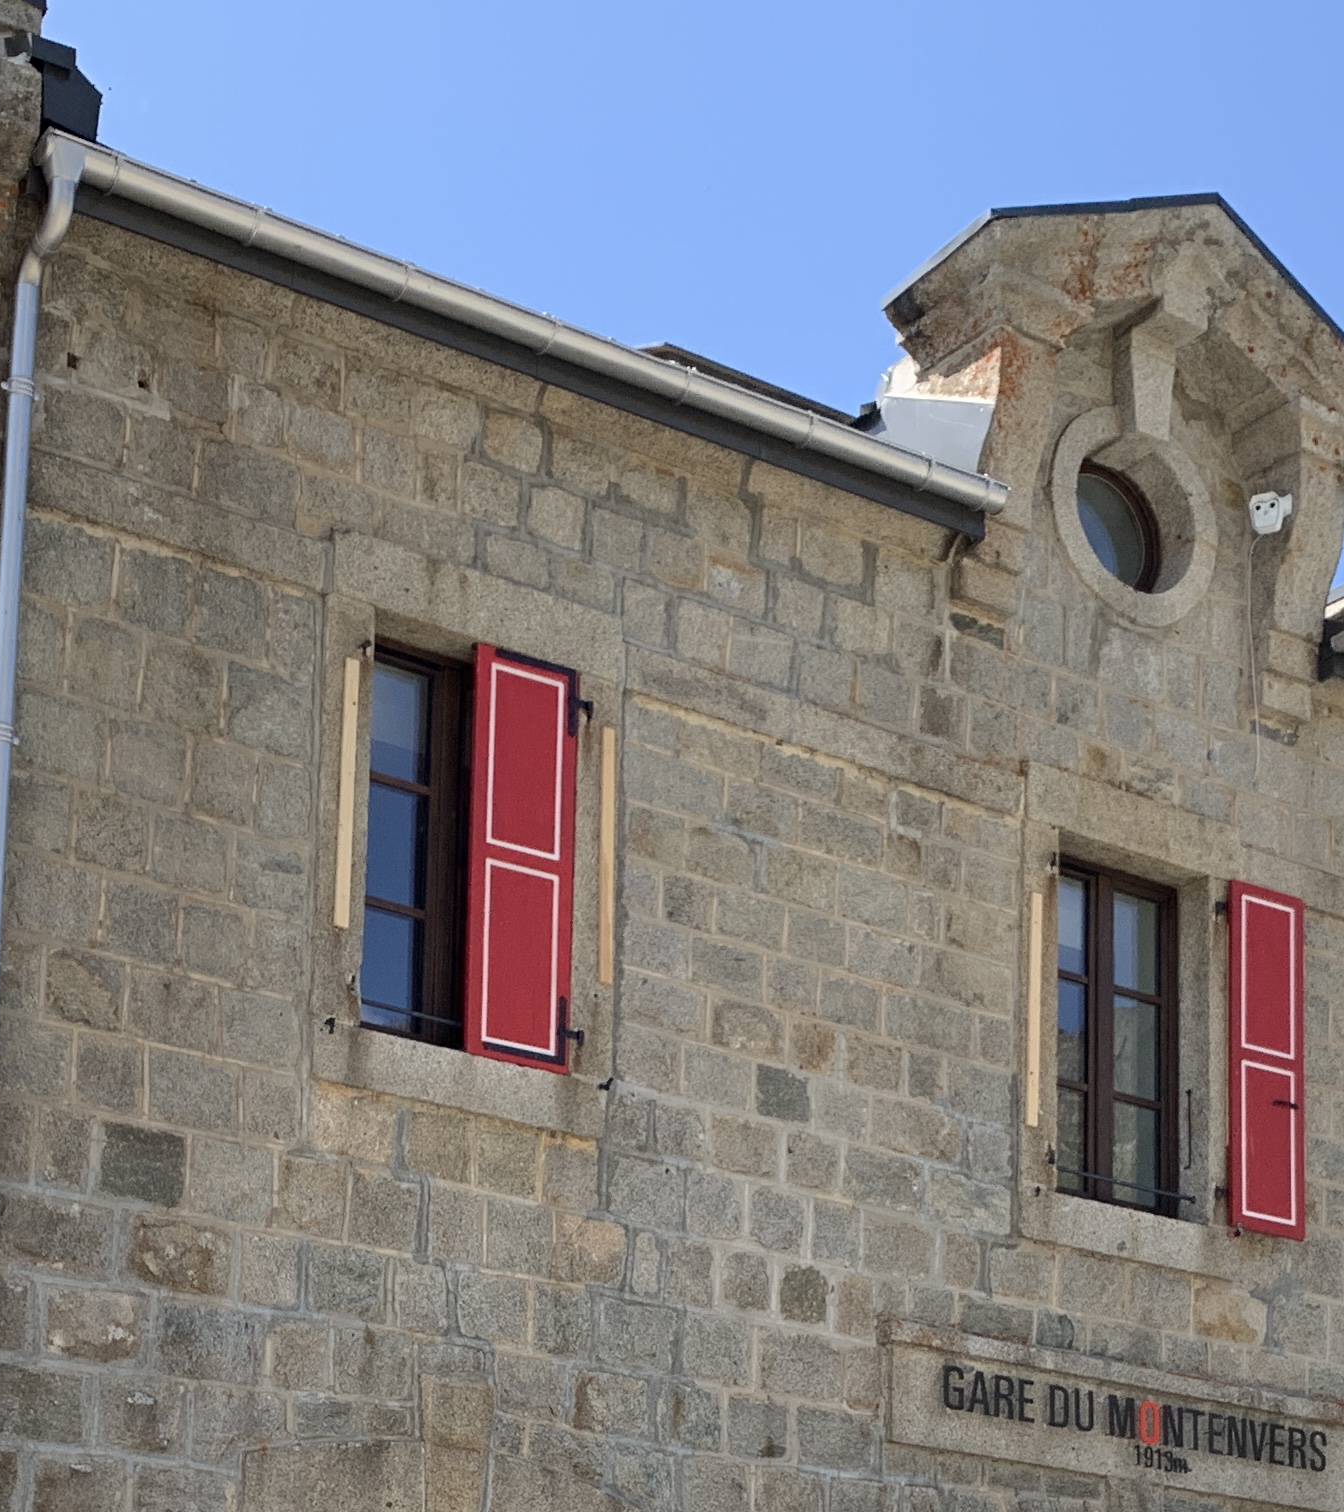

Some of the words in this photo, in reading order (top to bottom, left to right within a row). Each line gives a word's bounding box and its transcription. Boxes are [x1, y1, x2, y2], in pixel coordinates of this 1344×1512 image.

[941, 1364, 1035, 1424] GARE
[1047, 1384, 1095, 1432] DU
[1106, 1395, 1327, 1473] MONTENVERS
